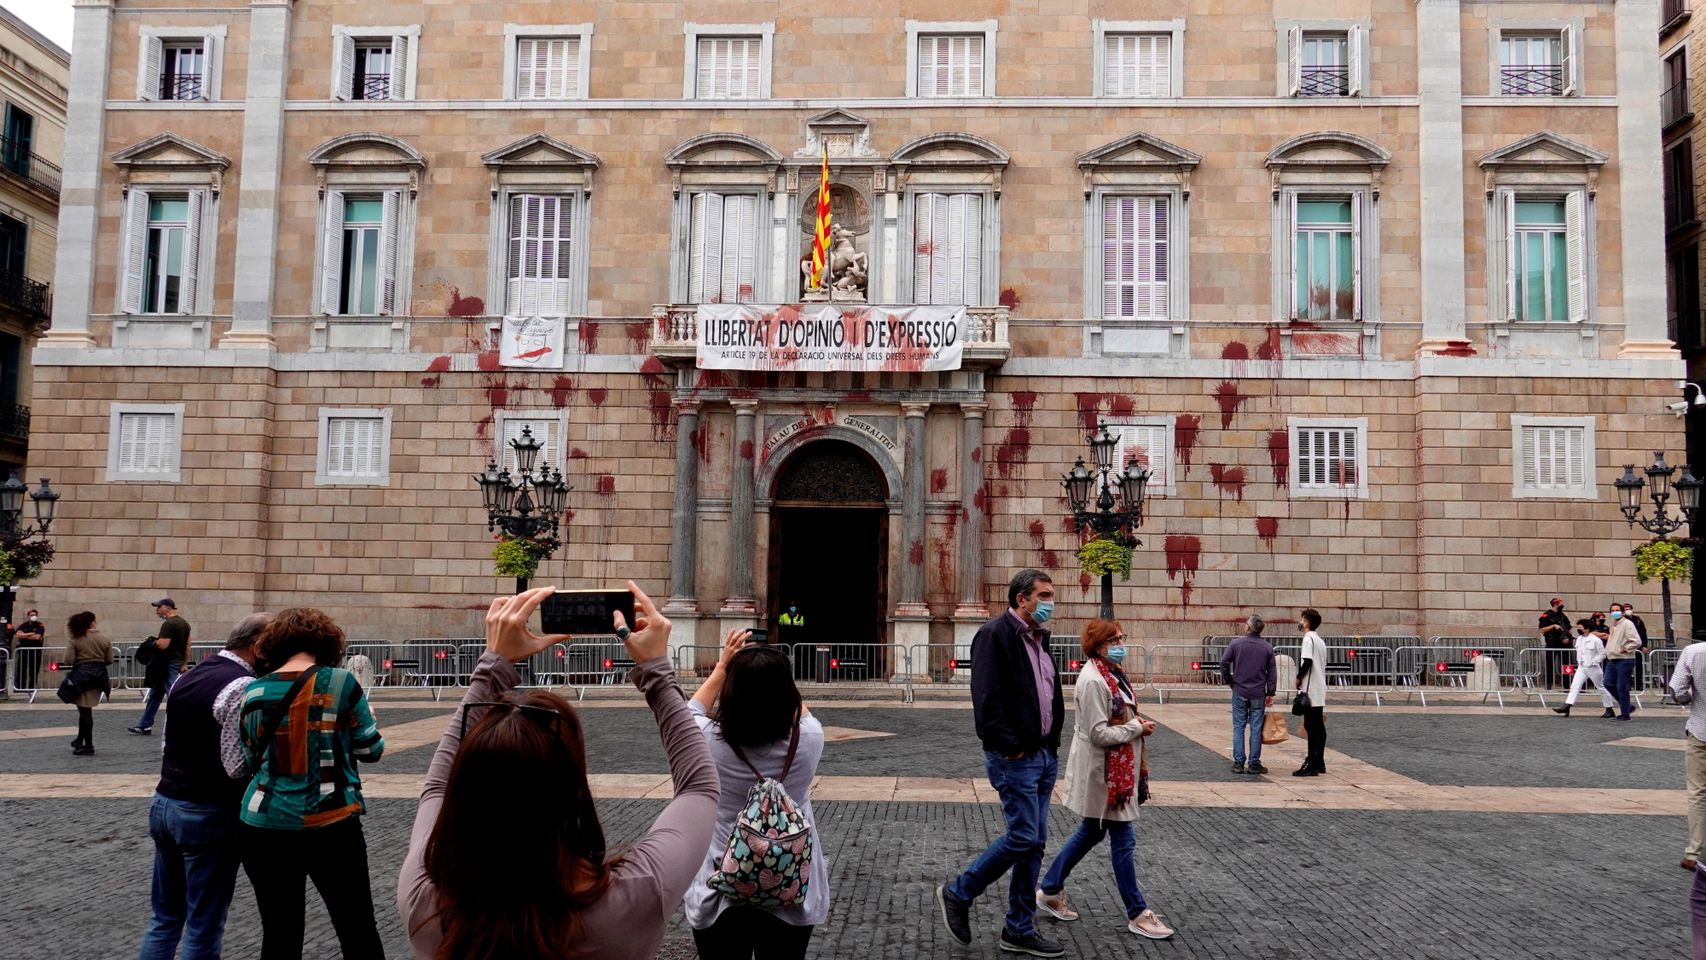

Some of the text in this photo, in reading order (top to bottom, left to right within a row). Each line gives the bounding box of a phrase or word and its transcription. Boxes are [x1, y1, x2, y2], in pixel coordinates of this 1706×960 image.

[704, 315, 957, 348] LLIBERTAT D'OPINIÓ I D'EXPRESSIÓ
[721, 349, 940, 360] ARTICLE 19 DE LA DECLARACIÓ UNIVERSAL DELS DRETS HUMANS
[765, 428, 791, 451] PALAU
[792, 421, 805, 431] DE
[843, 417, 897, 451] GENERALITAT
